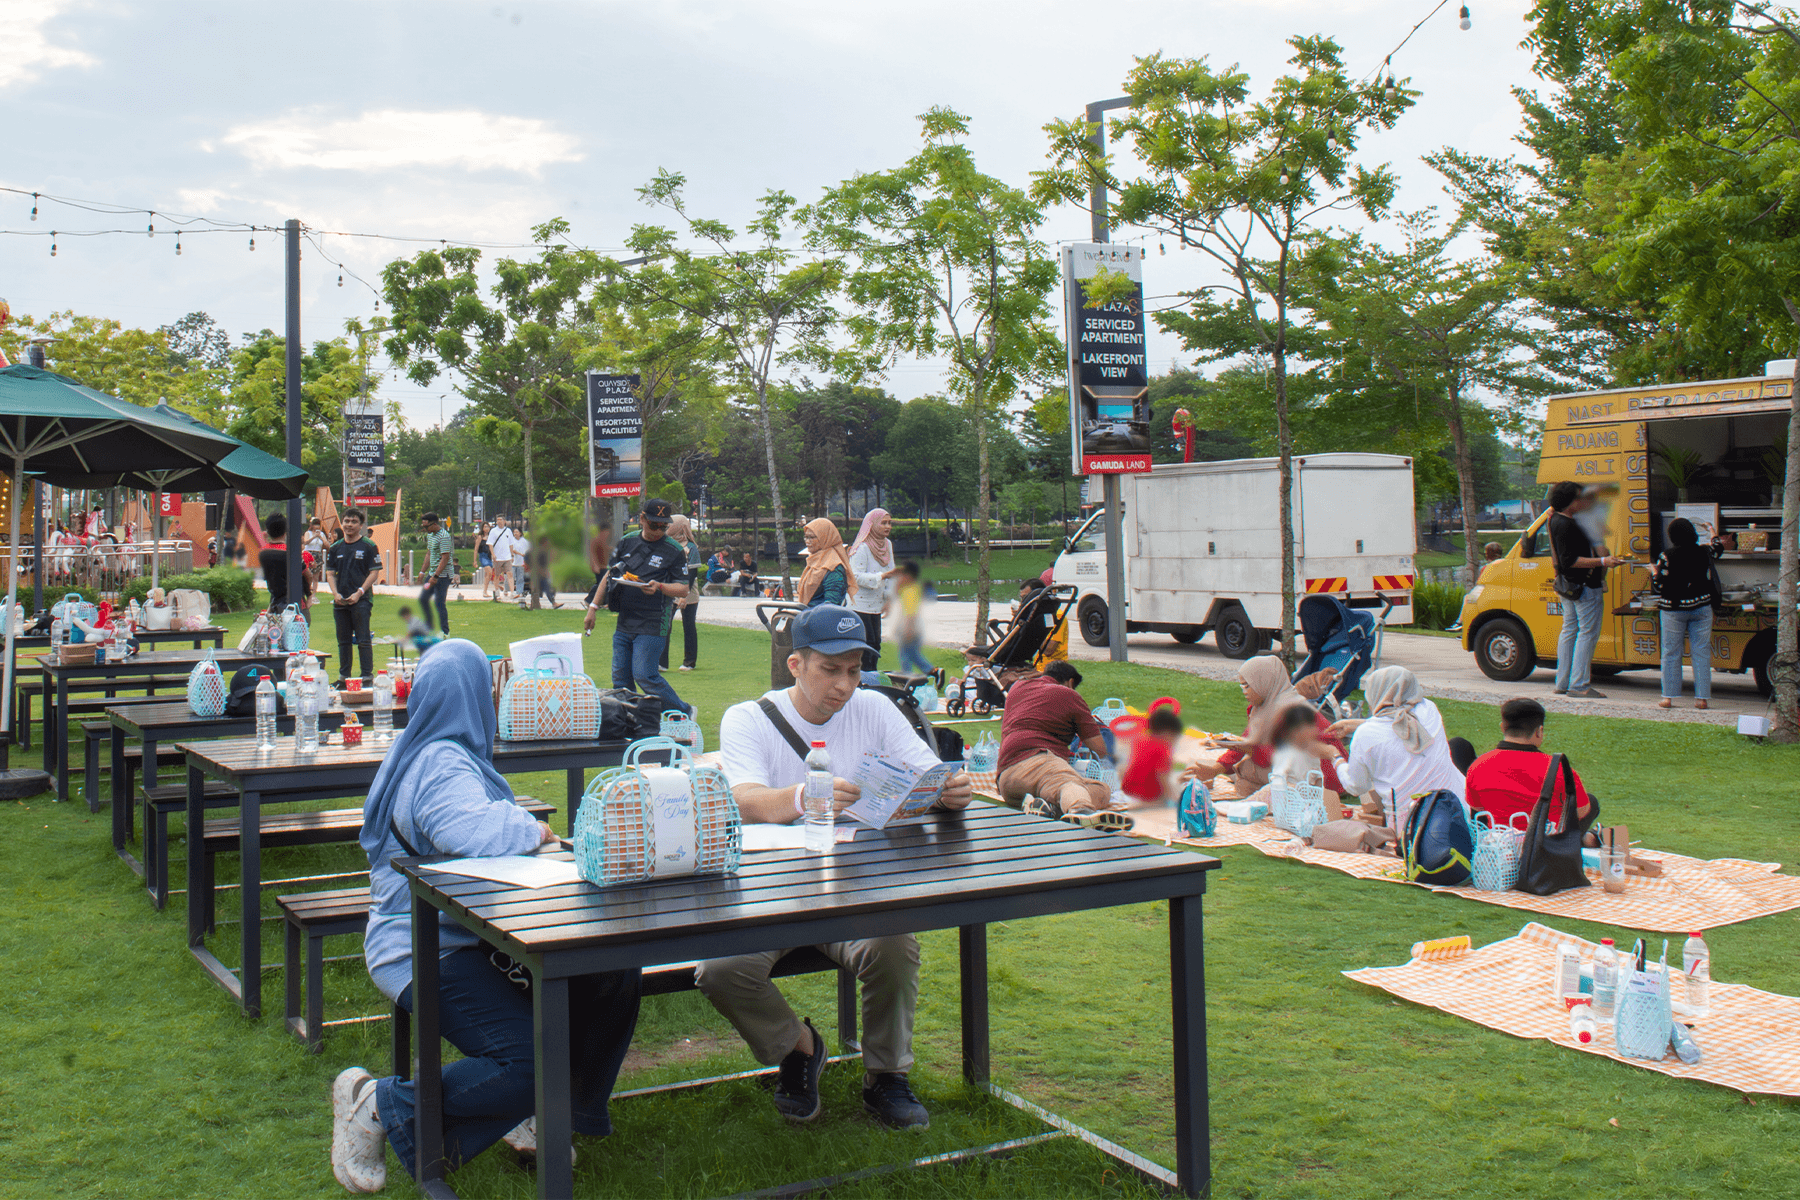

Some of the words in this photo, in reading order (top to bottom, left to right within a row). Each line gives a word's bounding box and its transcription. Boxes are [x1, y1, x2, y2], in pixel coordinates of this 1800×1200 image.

[1096, 301, 1131, 312] LAZA
[1085, 318, 1135, 330] SERVICED
[1081, 331, 1144, 344] APARTMENT
[1082, 352, 1144, 365] LAKEFRONT
[1100, 366, 1128, 377] VIEW
[599, 397, 634, 405] SERVICED
[595, 418, 642, 427] RESORT-STYLE
[601, 426, 638, 435] FACILITIES
[1558, 431, 1618, 450] PADANG
[1090, 461, 1124, 470] GAMUDA
[1126, 460, 1146, 469] LAND
[1574, 459, 1615, 475] ASLI
[654, 792, 689, 808] Family
[664, 803, 690, 819] Day
